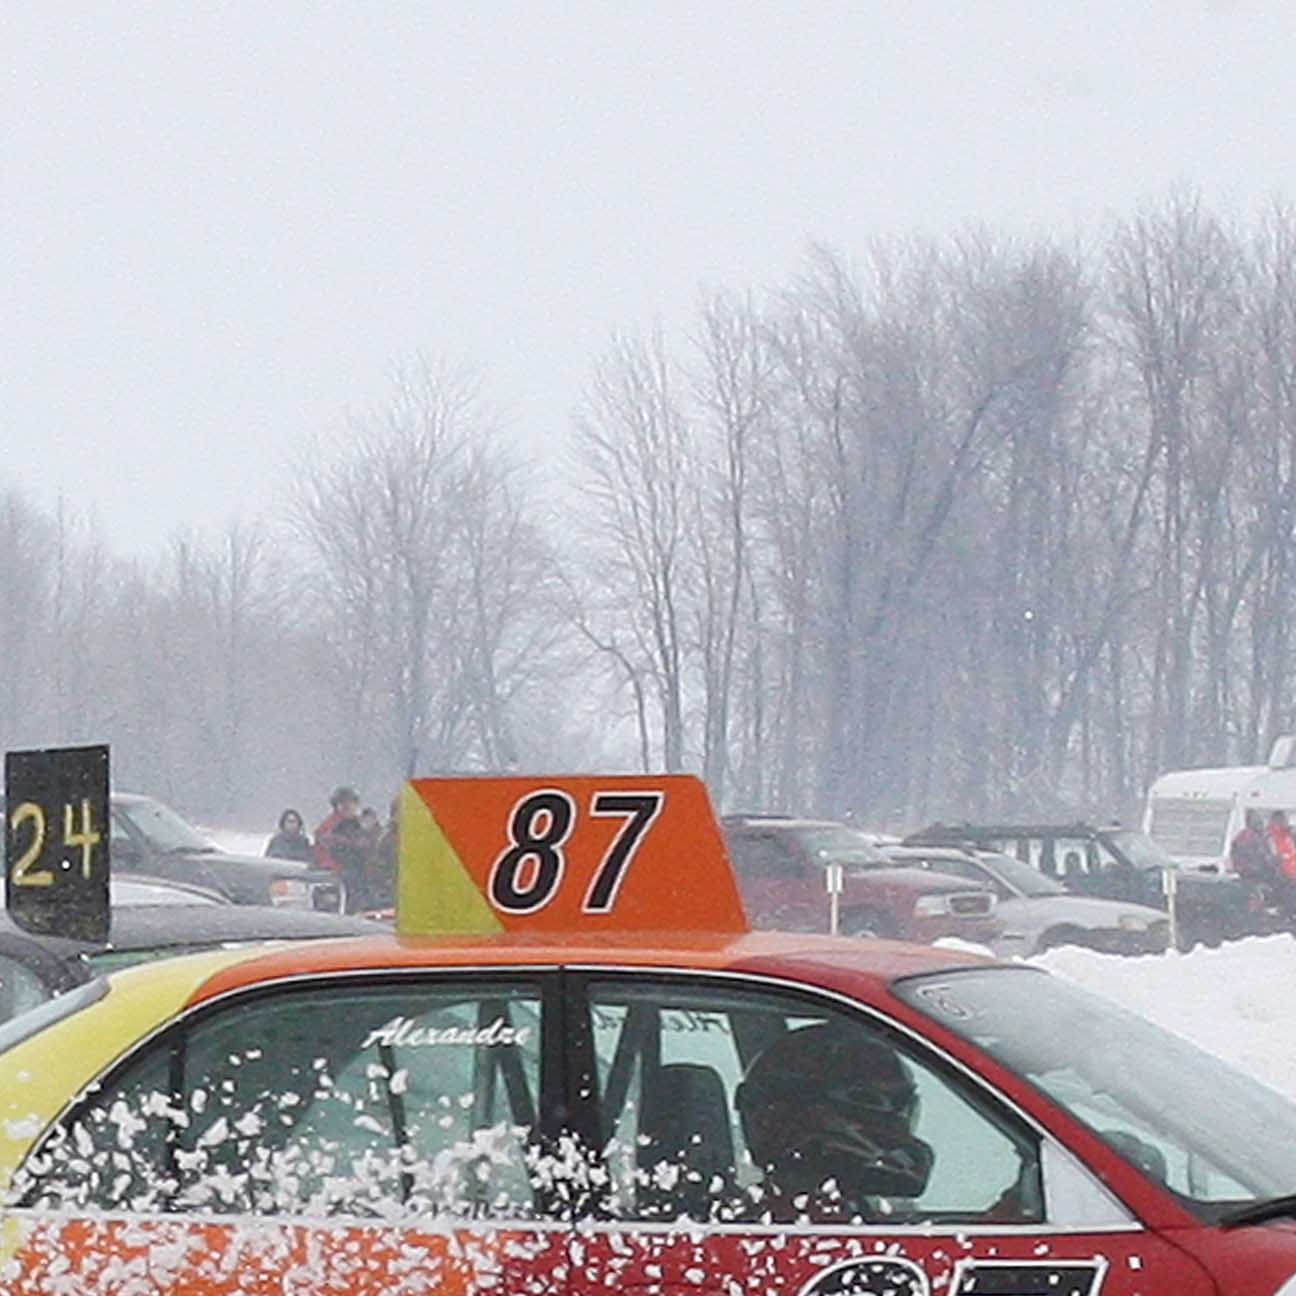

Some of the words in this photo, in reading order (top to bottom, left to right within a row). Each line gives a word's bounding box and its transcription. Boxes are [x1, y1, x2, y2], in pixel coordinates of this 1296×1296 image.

[10, 799, 101, 887] 24
[488, 788, 665, 914] 87
[360, 1016, 531, 1049] Alexandre
